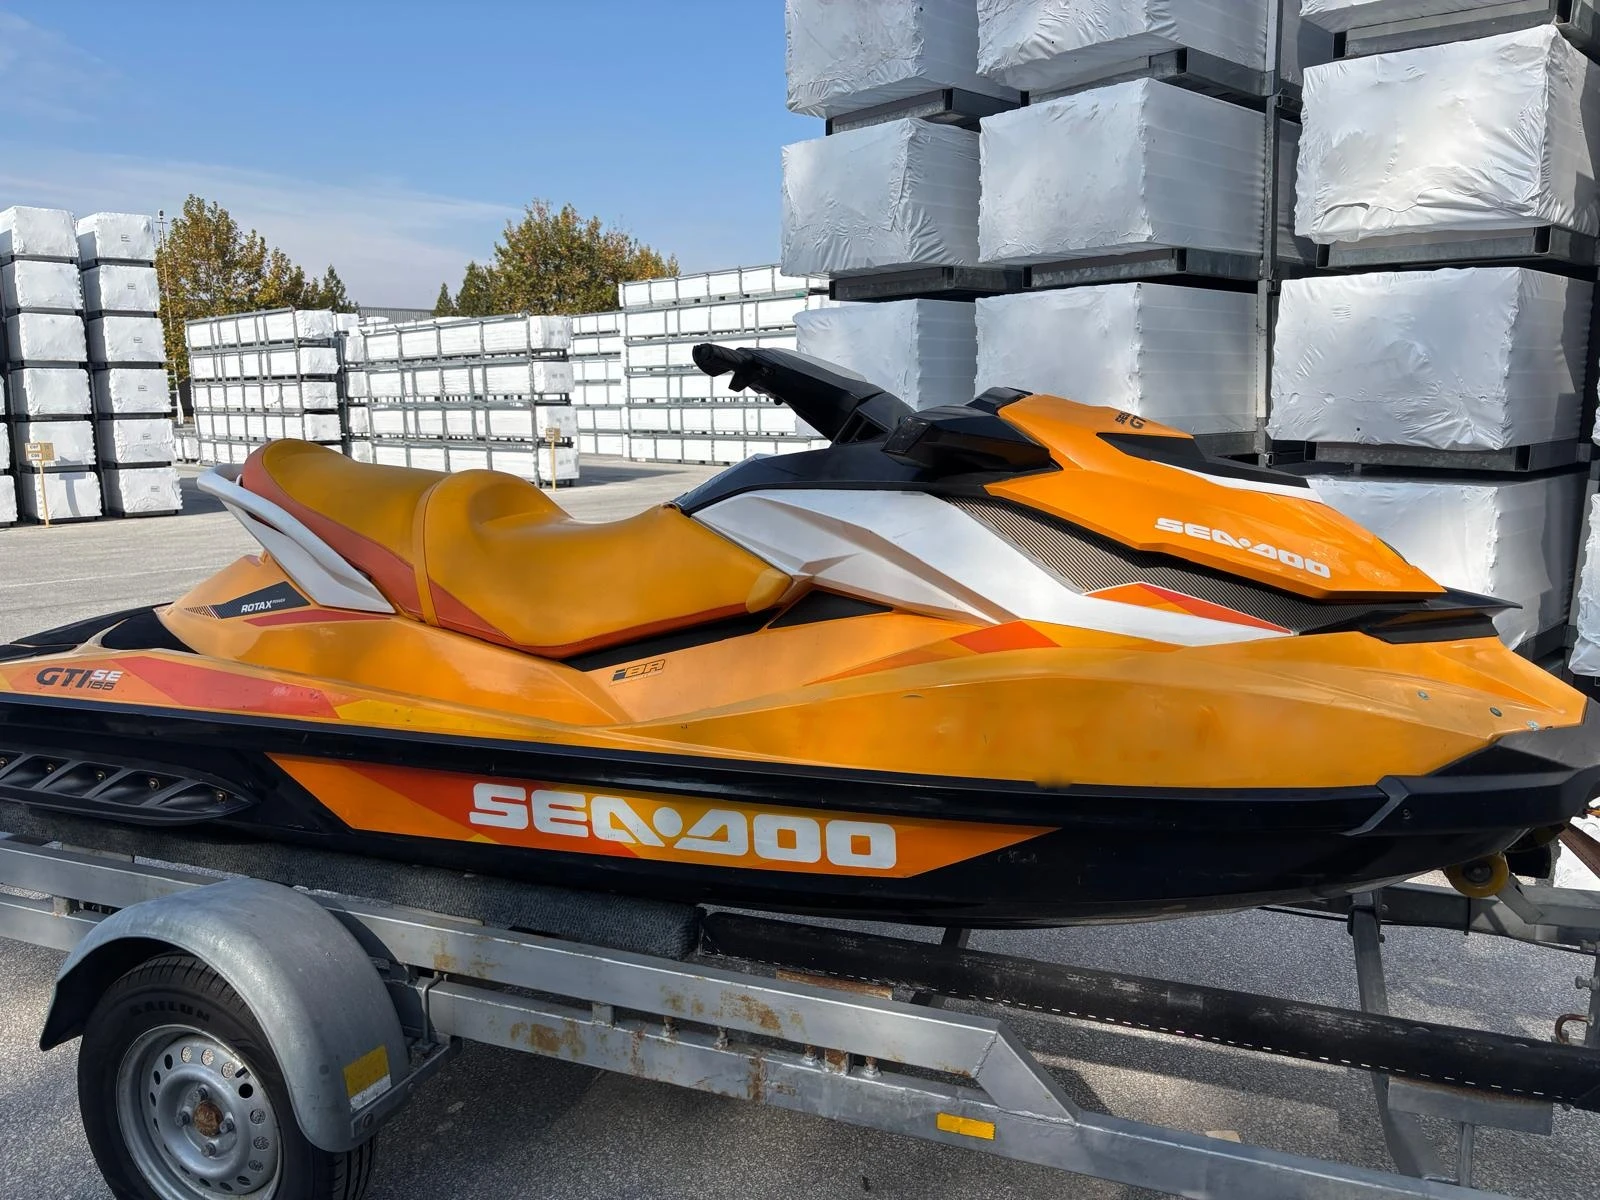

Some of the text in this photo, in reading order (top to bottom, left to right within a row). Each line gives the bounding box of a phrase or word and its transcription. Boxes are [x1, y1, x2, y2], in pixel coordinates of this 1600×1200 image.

[240, 600, 273, 613] ROTAX
[36, 667, 123, 688] GTI SE
[129, 1000, 211, 1022] SAILUN
